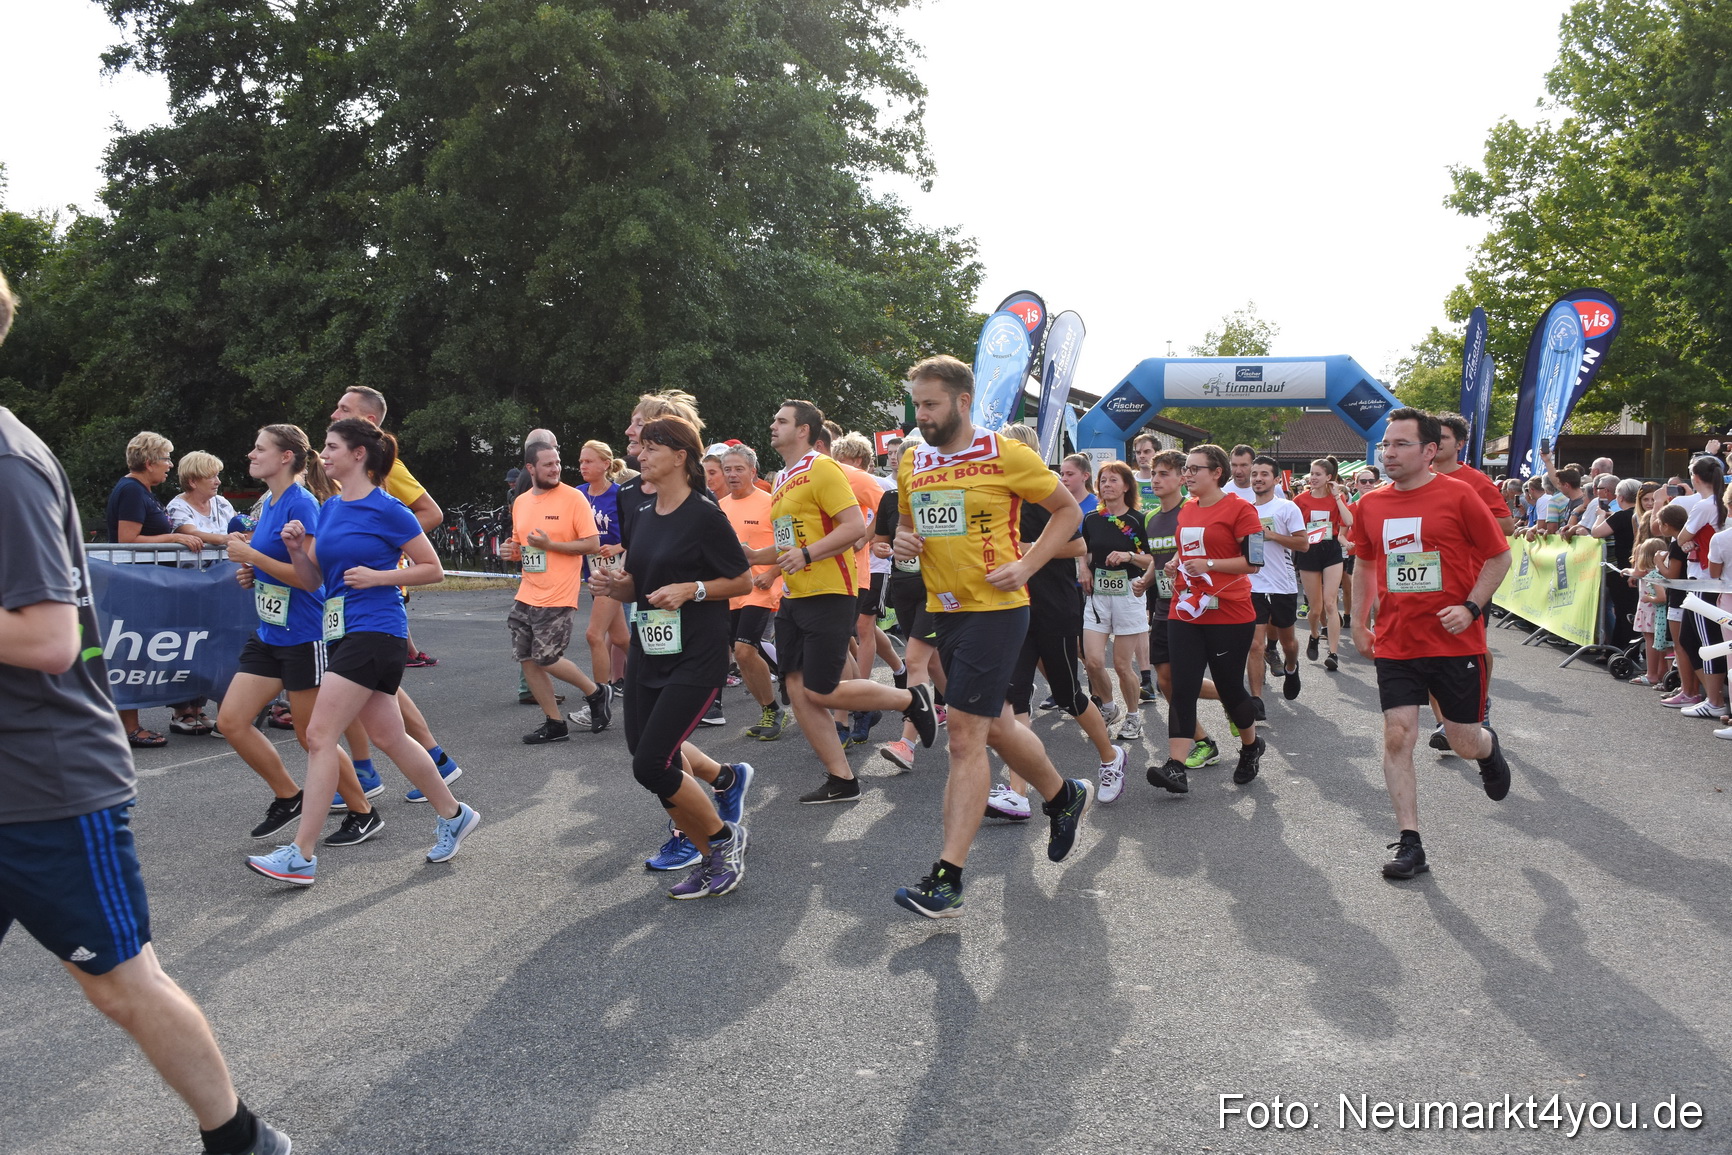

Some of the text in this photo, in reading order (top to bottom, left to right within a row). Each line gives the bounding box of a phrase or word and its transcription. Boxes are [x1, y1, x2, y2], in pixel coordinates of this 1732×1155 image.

[1053, 325, 1074, 380] Fischer
[1469, 322, 1482, 381] Fischer
[1225, 381, 1286, 393] firmenlauf
[1112, 401, 1145, 410] Fischer
[785, 475, 811, 493] BÖGL
[911, 463, 1004, 490] MAX BÖGL
[918, 506, 958, 524] 1620
[775, 527, 791, 543] 1560
[521, 555, 541, 565] 2311
[591, 556, 616, 568] 1719
[1397, 567, 1428, 582] 507
[1097, 578, 1124, 589] 1968
[256, 594, 282, 614] 1142
[102, 620, 209, 662] her
[642, 625, 673, 643] 1866
[109, 669, 191, 686] OBILE
